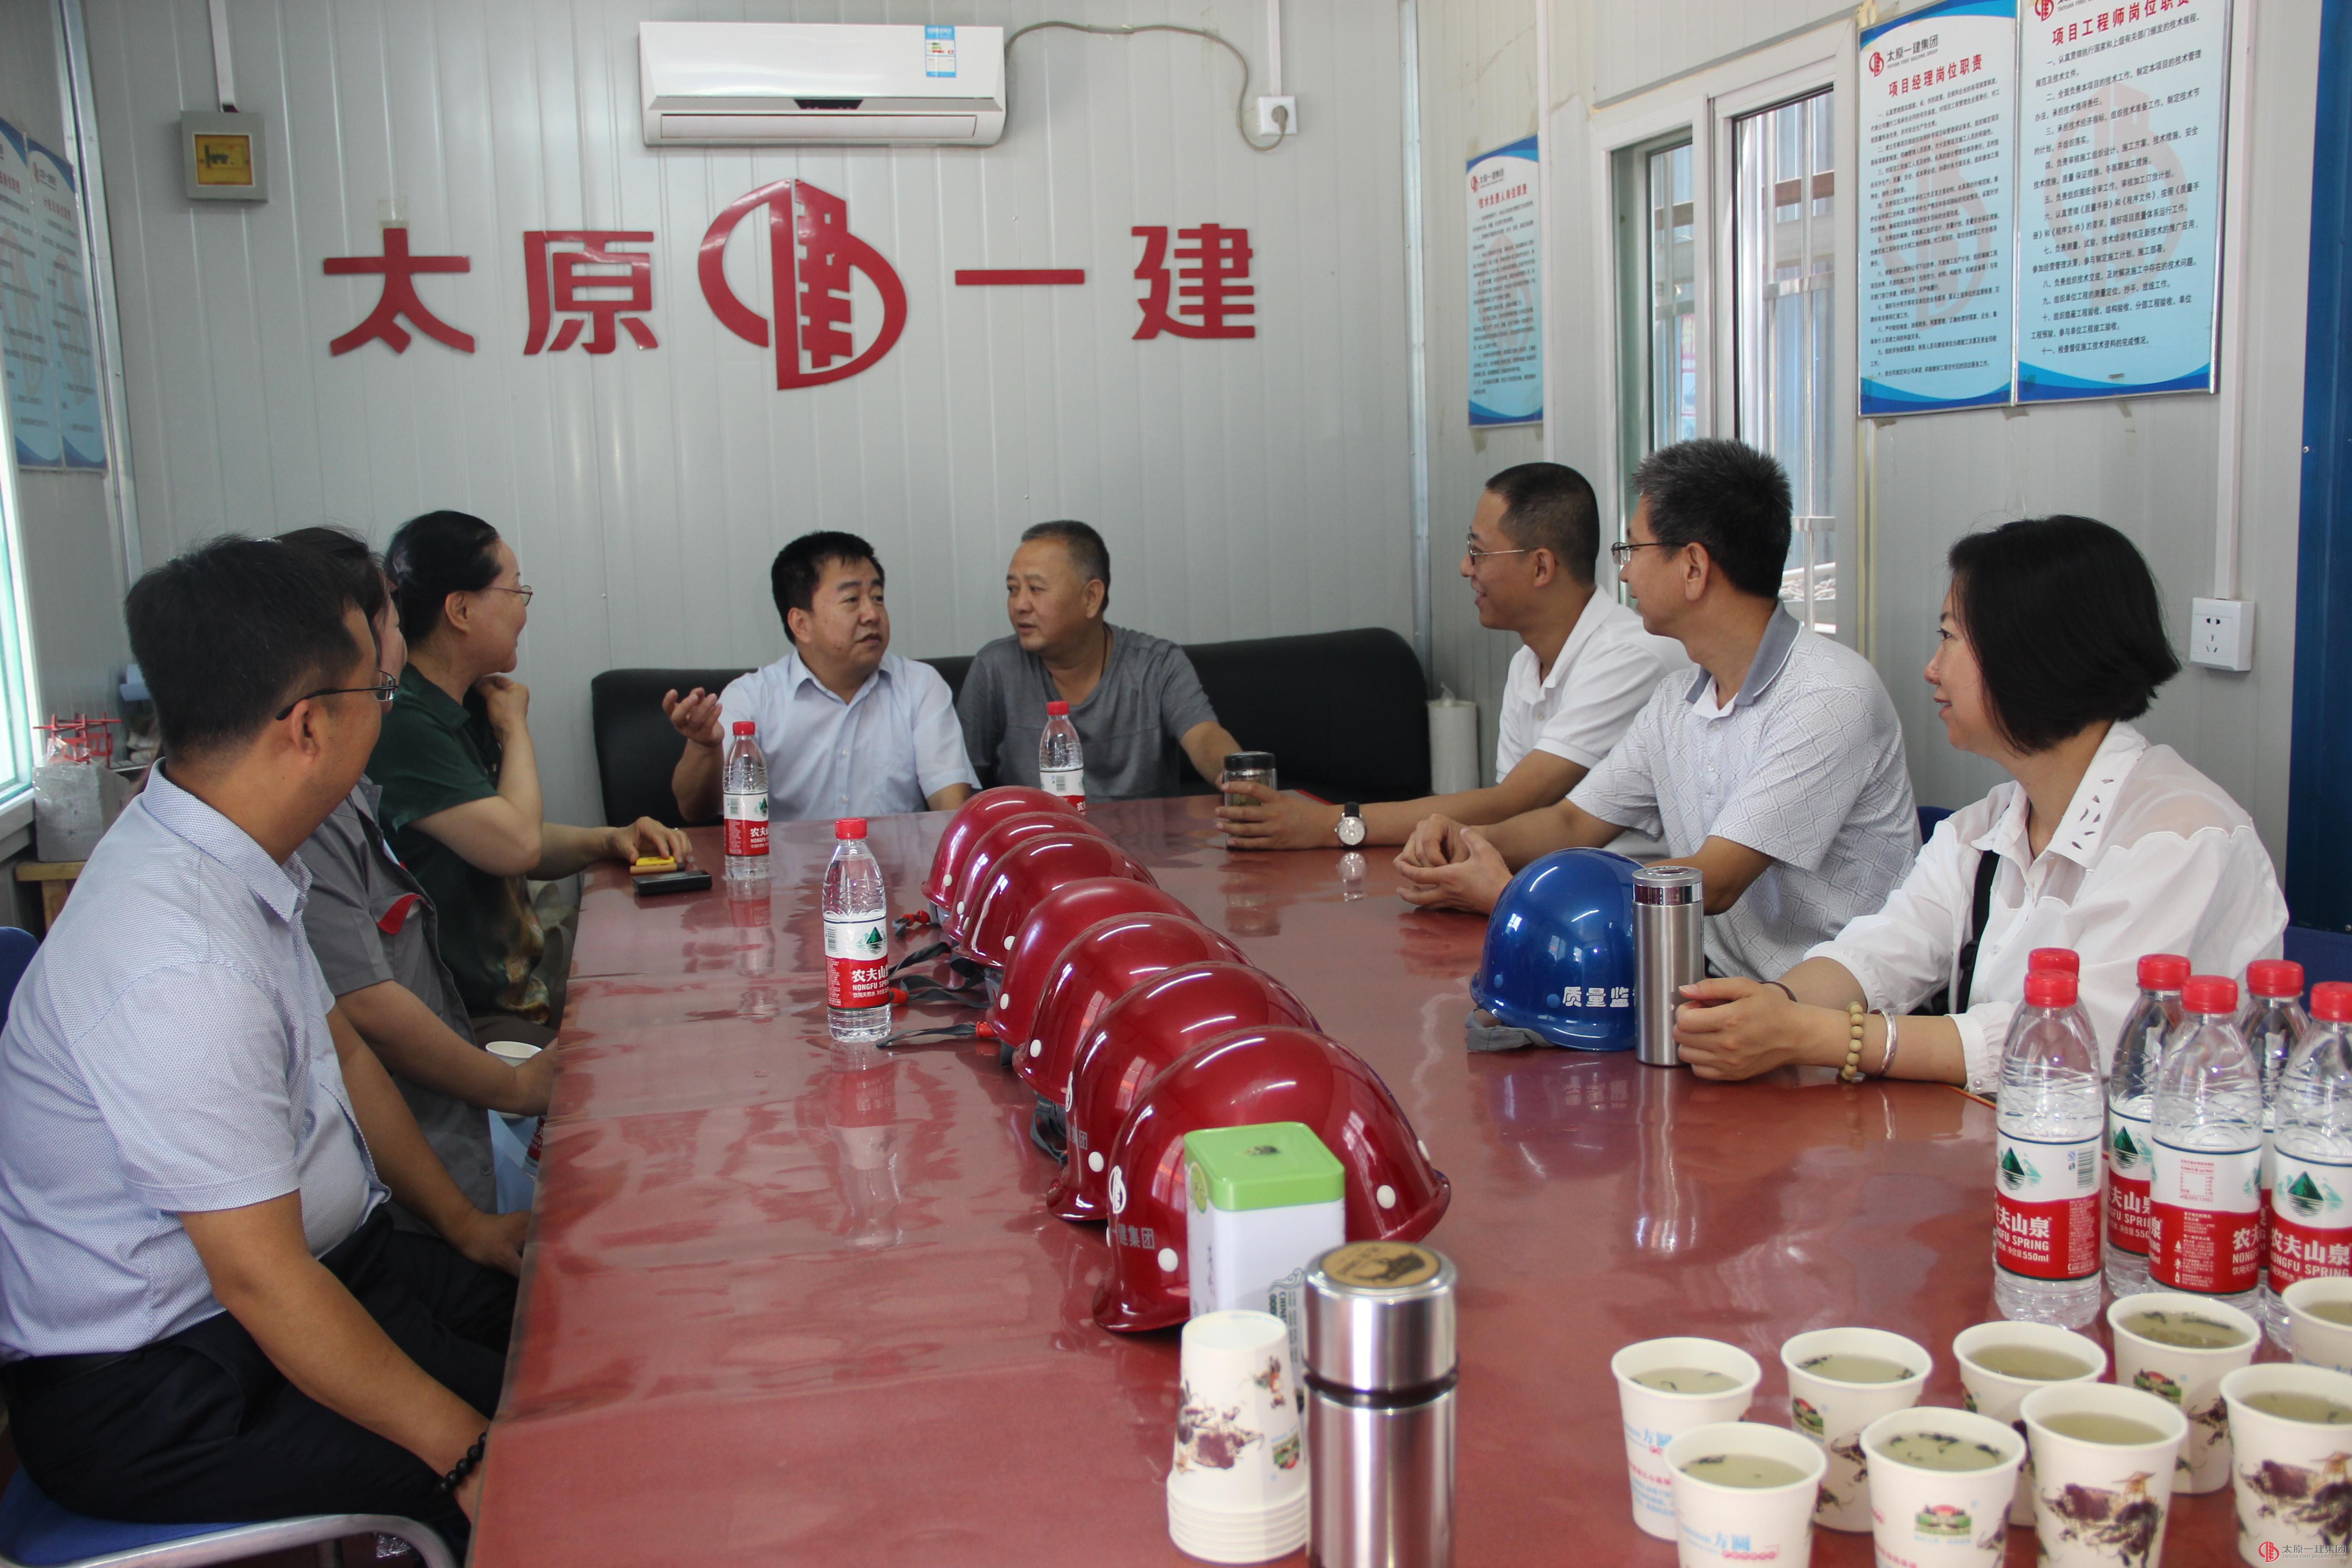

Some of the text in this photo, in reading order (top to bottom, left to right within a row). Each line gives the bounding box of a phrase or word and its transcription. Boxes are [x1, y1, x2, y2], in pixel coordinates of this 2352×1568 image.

[1886, 34, 1938, 63] 太原一建集团
[1888, 54, 1982, 98] 项目经理岗位职责
[2035, 67, 2079, 88] 规范及技术文件。
[325, 224, 1254, 354] 太原 一建
[853, 983, 877, 991] NONGFU
[1563, 986, 1635, 1008] 质量监
[2012, 1235, 2049, 1251] SPRING
[2271, 1227, 2350, 1266] 农夫山泉
